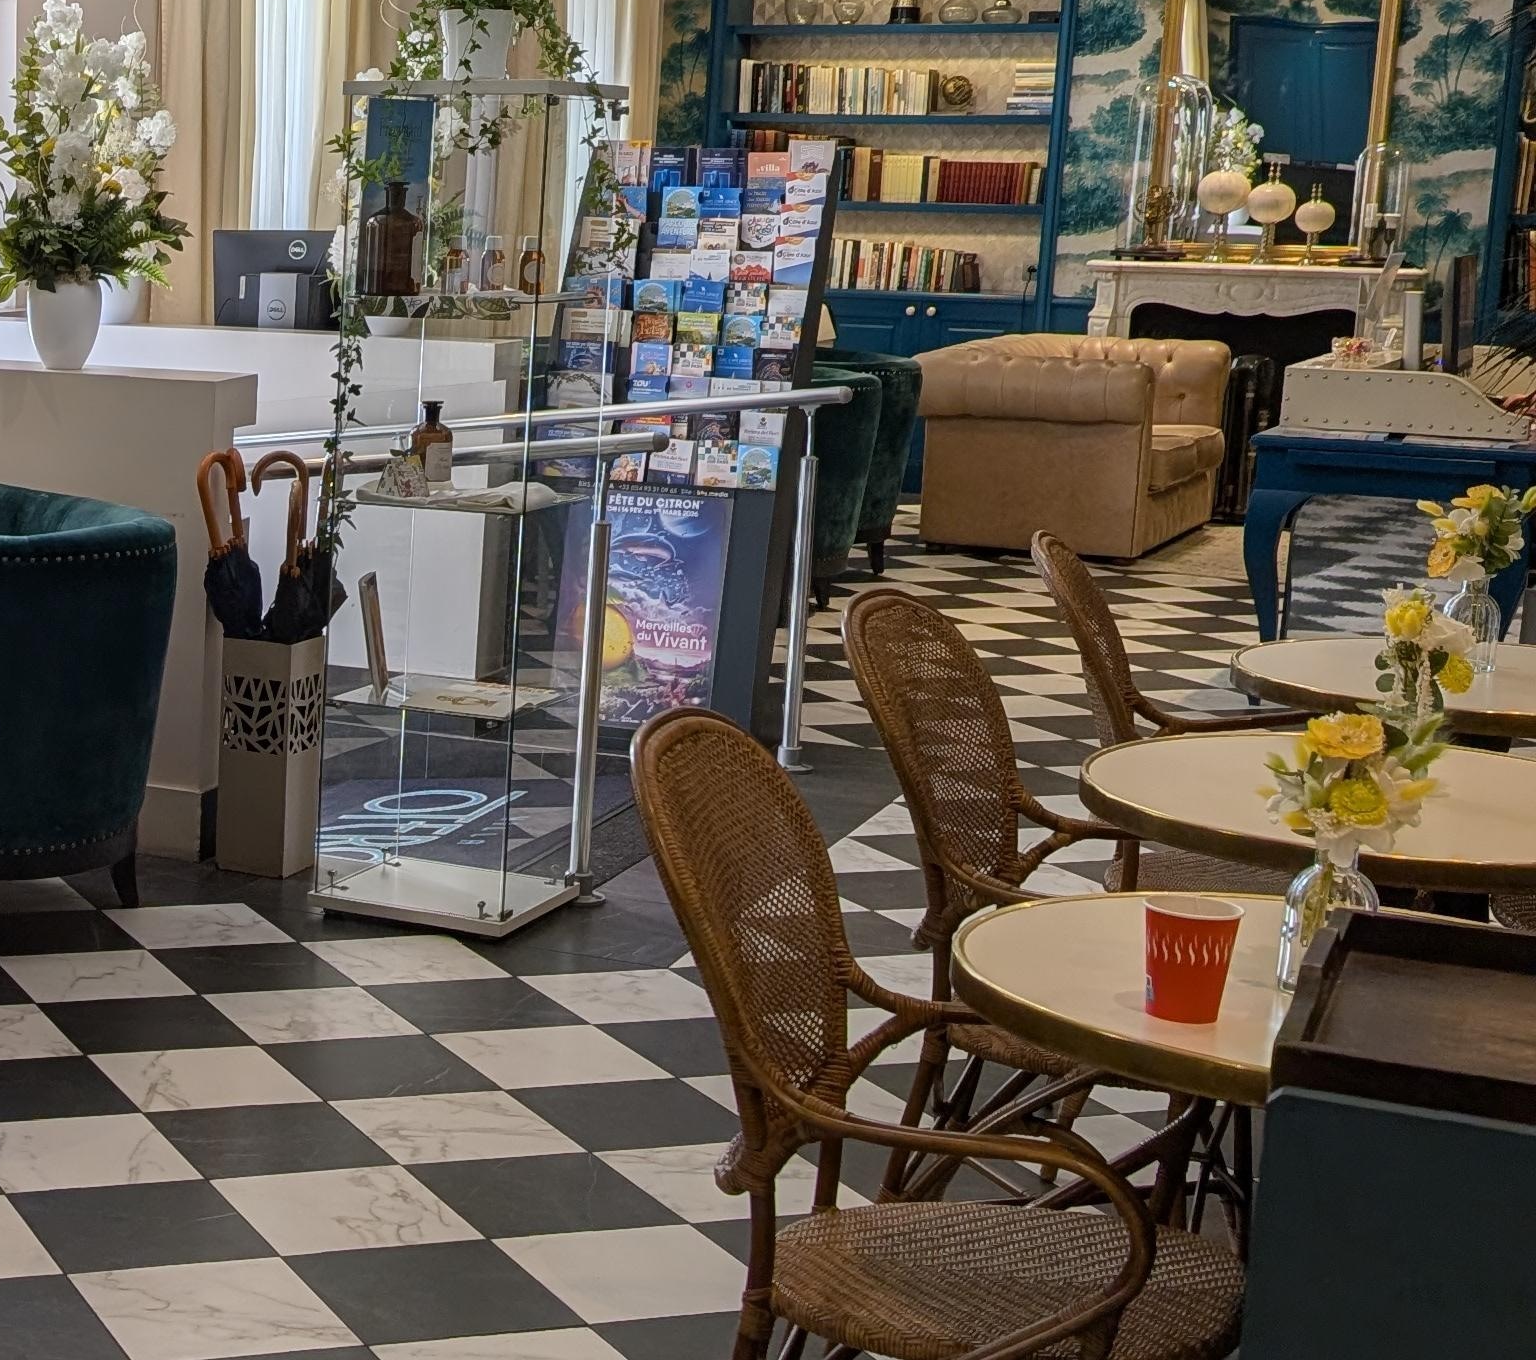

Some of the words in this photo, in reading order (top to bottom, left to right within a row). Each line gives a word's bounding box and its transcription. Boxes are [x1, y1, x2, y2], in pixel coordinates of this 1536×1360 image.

[608, 494, 636, 506] FÊTE
[636, 496, 654, 507] DU
[655, 498, 701, 510] CITRON
[635, 619, 692, 634] Merveilles
[636, 630, 652, 641] du
[653, 631, 708, 651] Vivant
